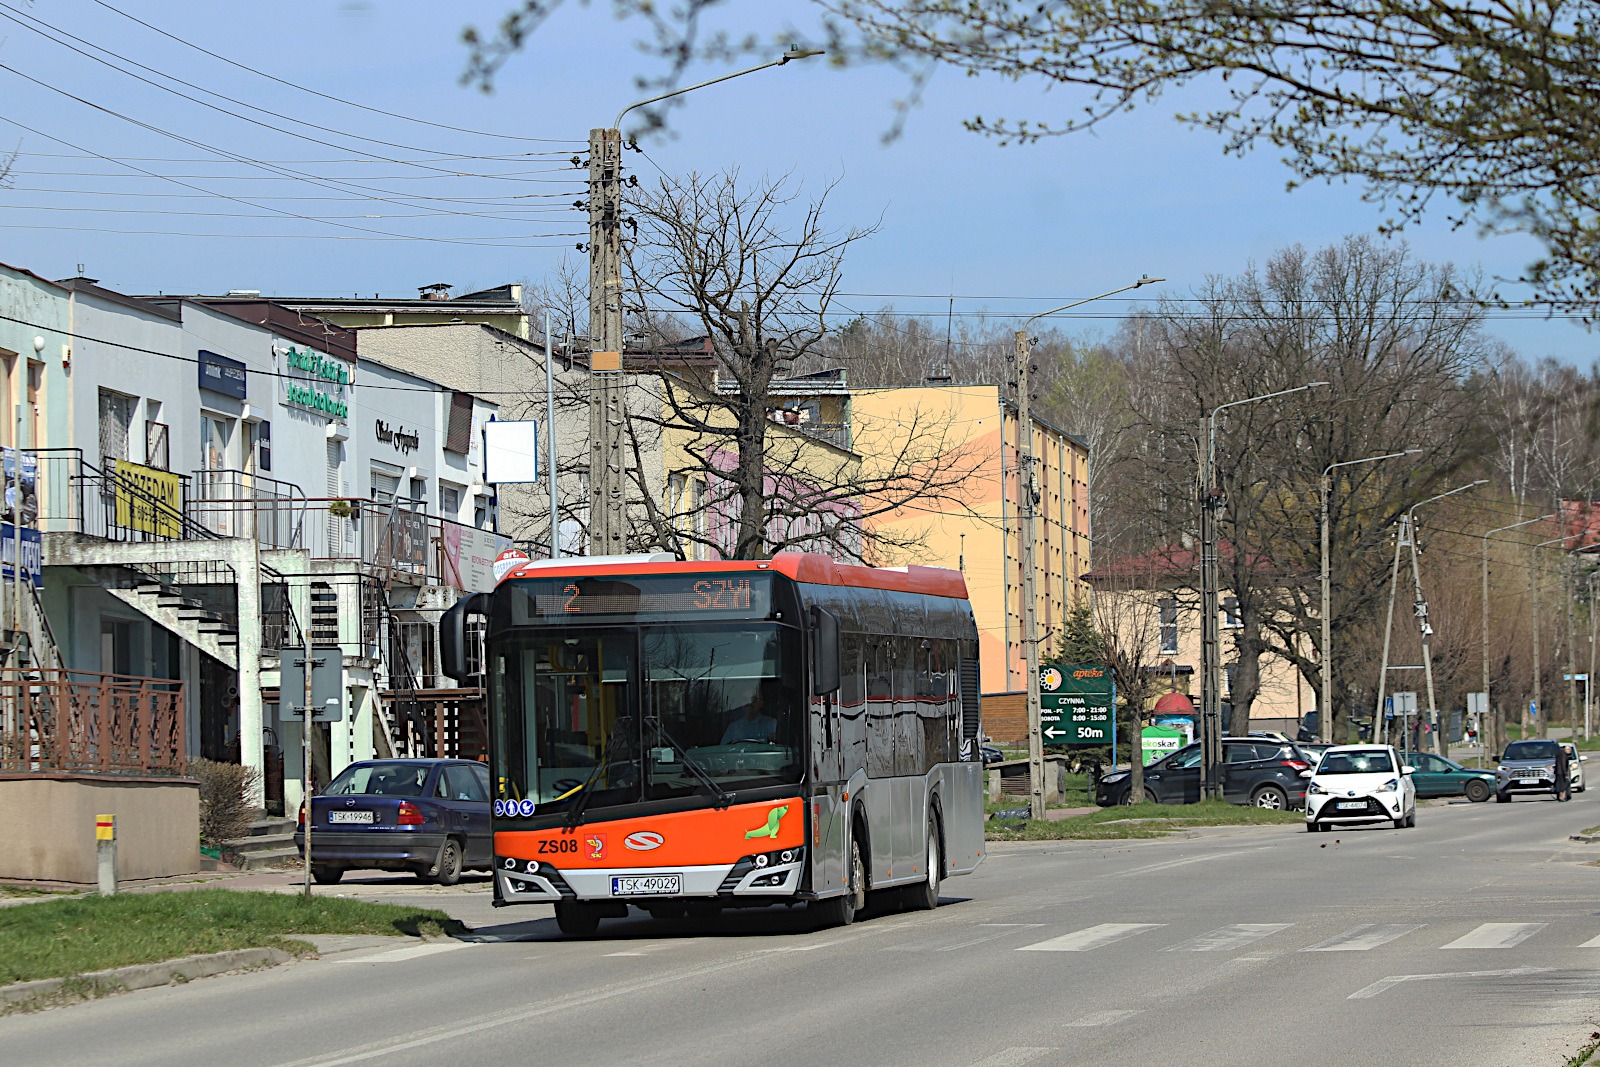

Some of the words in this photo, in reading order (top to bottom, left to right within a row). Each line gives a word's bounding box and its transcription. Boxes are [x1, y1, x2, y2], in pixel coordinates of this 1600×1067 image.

[563, 584, 581, 612] 2
[1073, 668, 1104, 680] apteka
[1058, 697, 1085, 705] CZYNNA
[1077, 727, 1103, 738] 50m
[538, 839, 578, 854] ZS08
